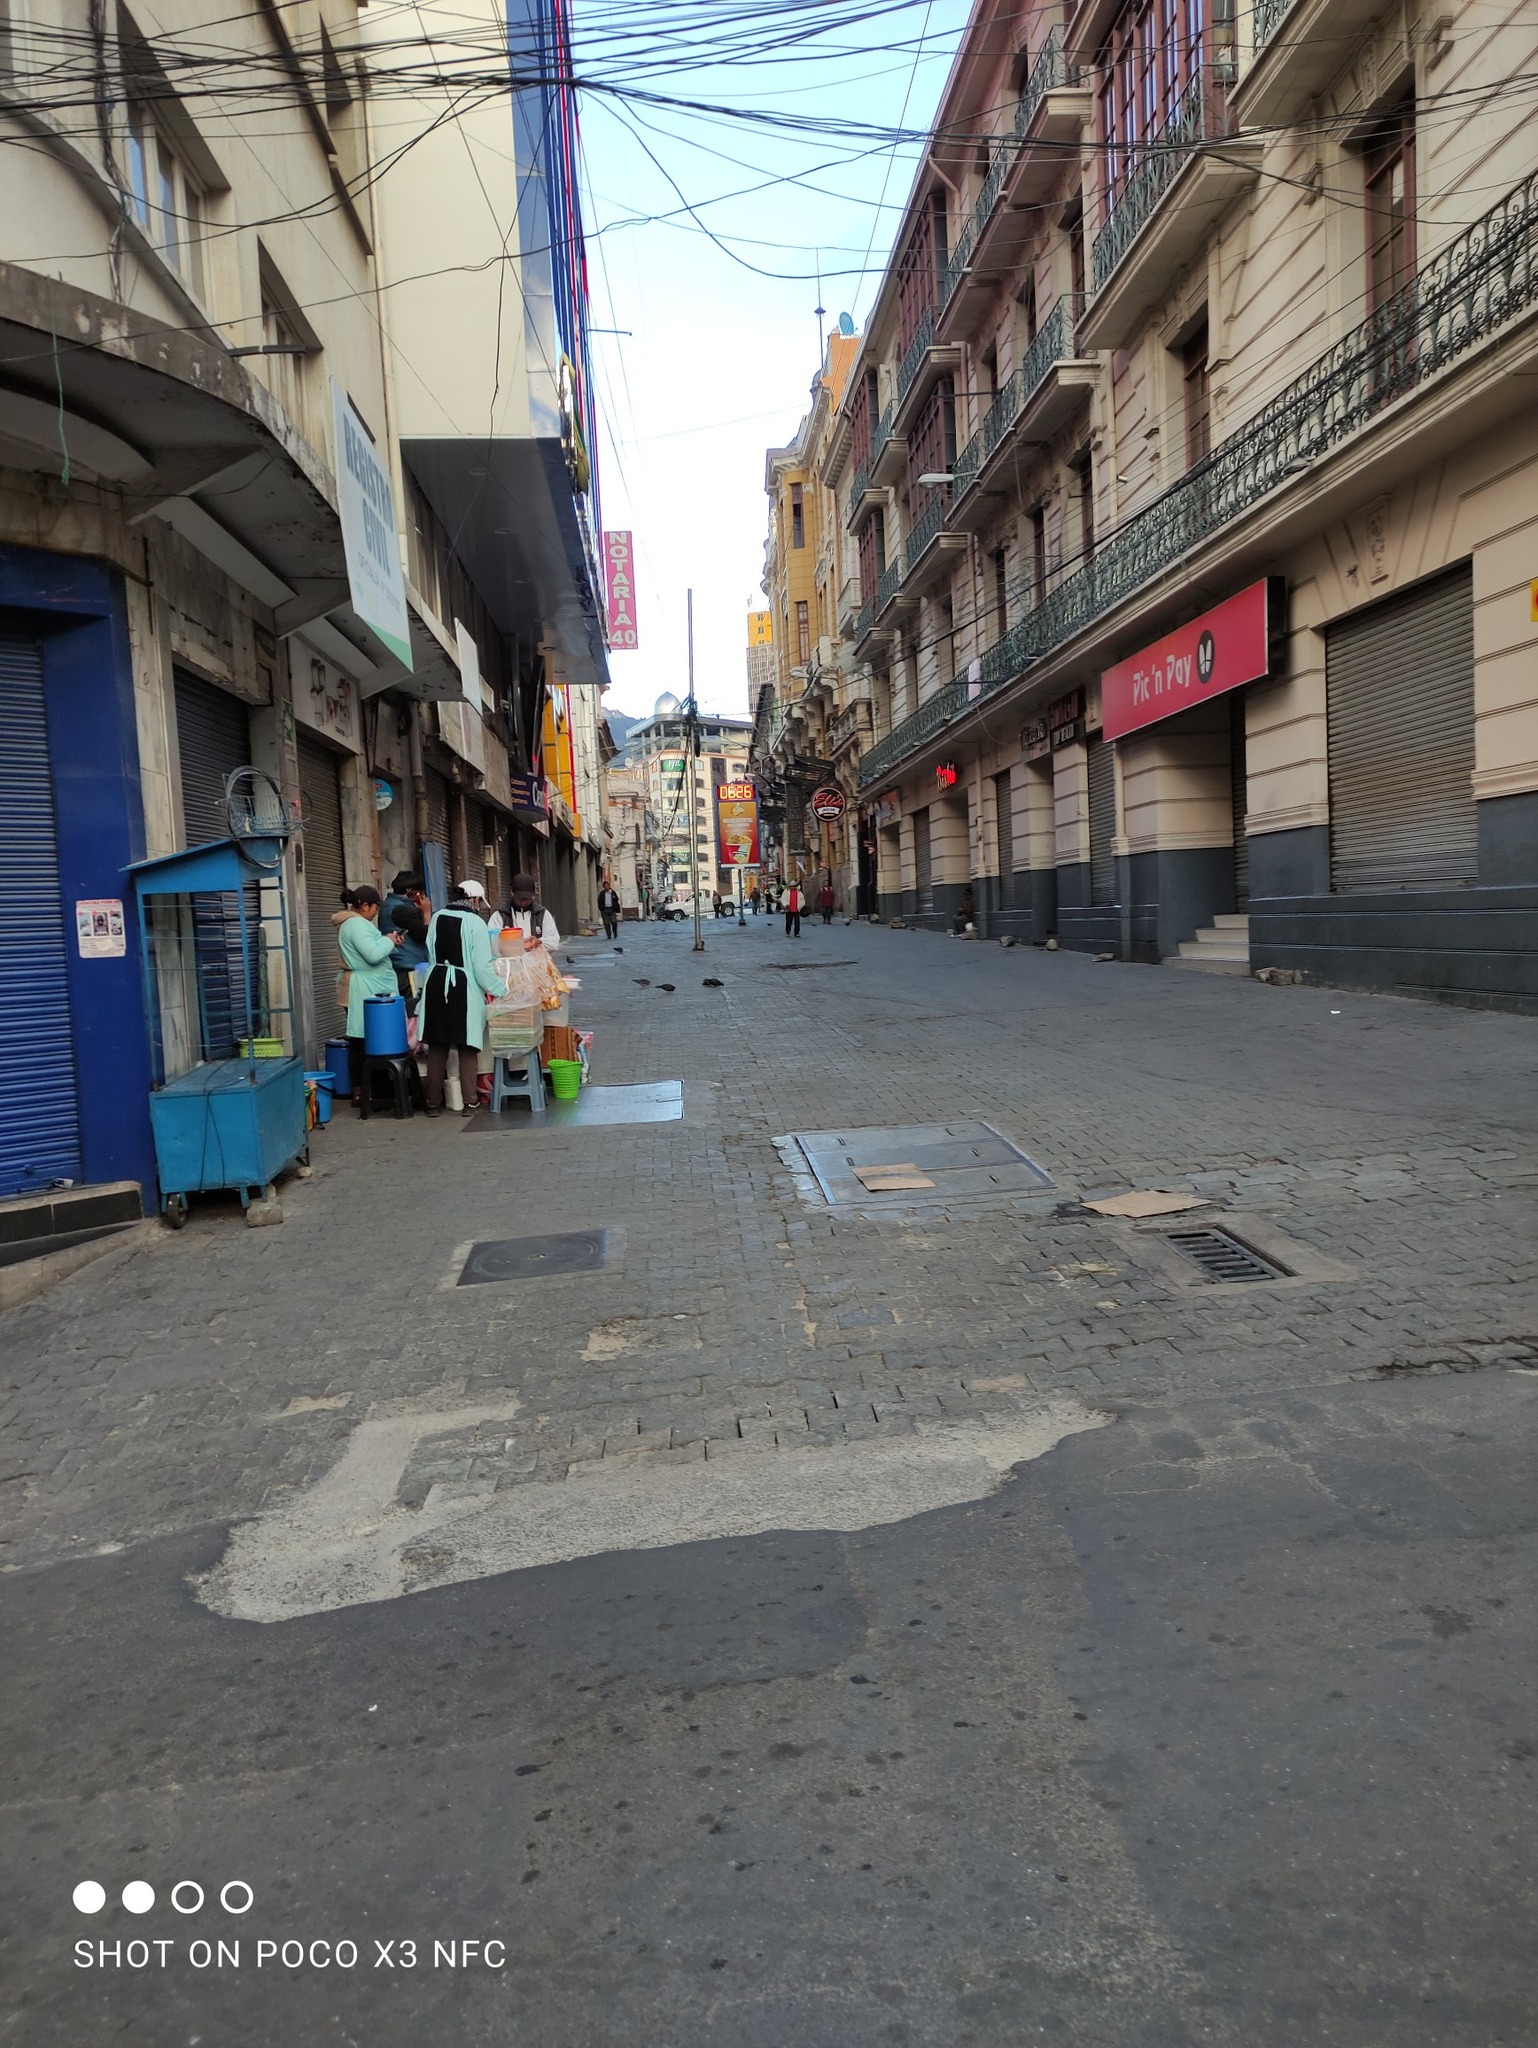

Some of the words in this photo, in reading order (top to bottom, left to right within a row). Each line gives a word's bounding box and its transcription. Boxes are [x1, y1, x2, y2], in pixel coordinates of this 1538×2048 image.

[343, 411, 393, 534] REGISTRO
[363, 496, 390, 578] CIVIL
[609, 532, 632, 626] NOTARIA
[1133, 670, 1149, 706] Pic
[1166, 654, 1191, 690] Pay
